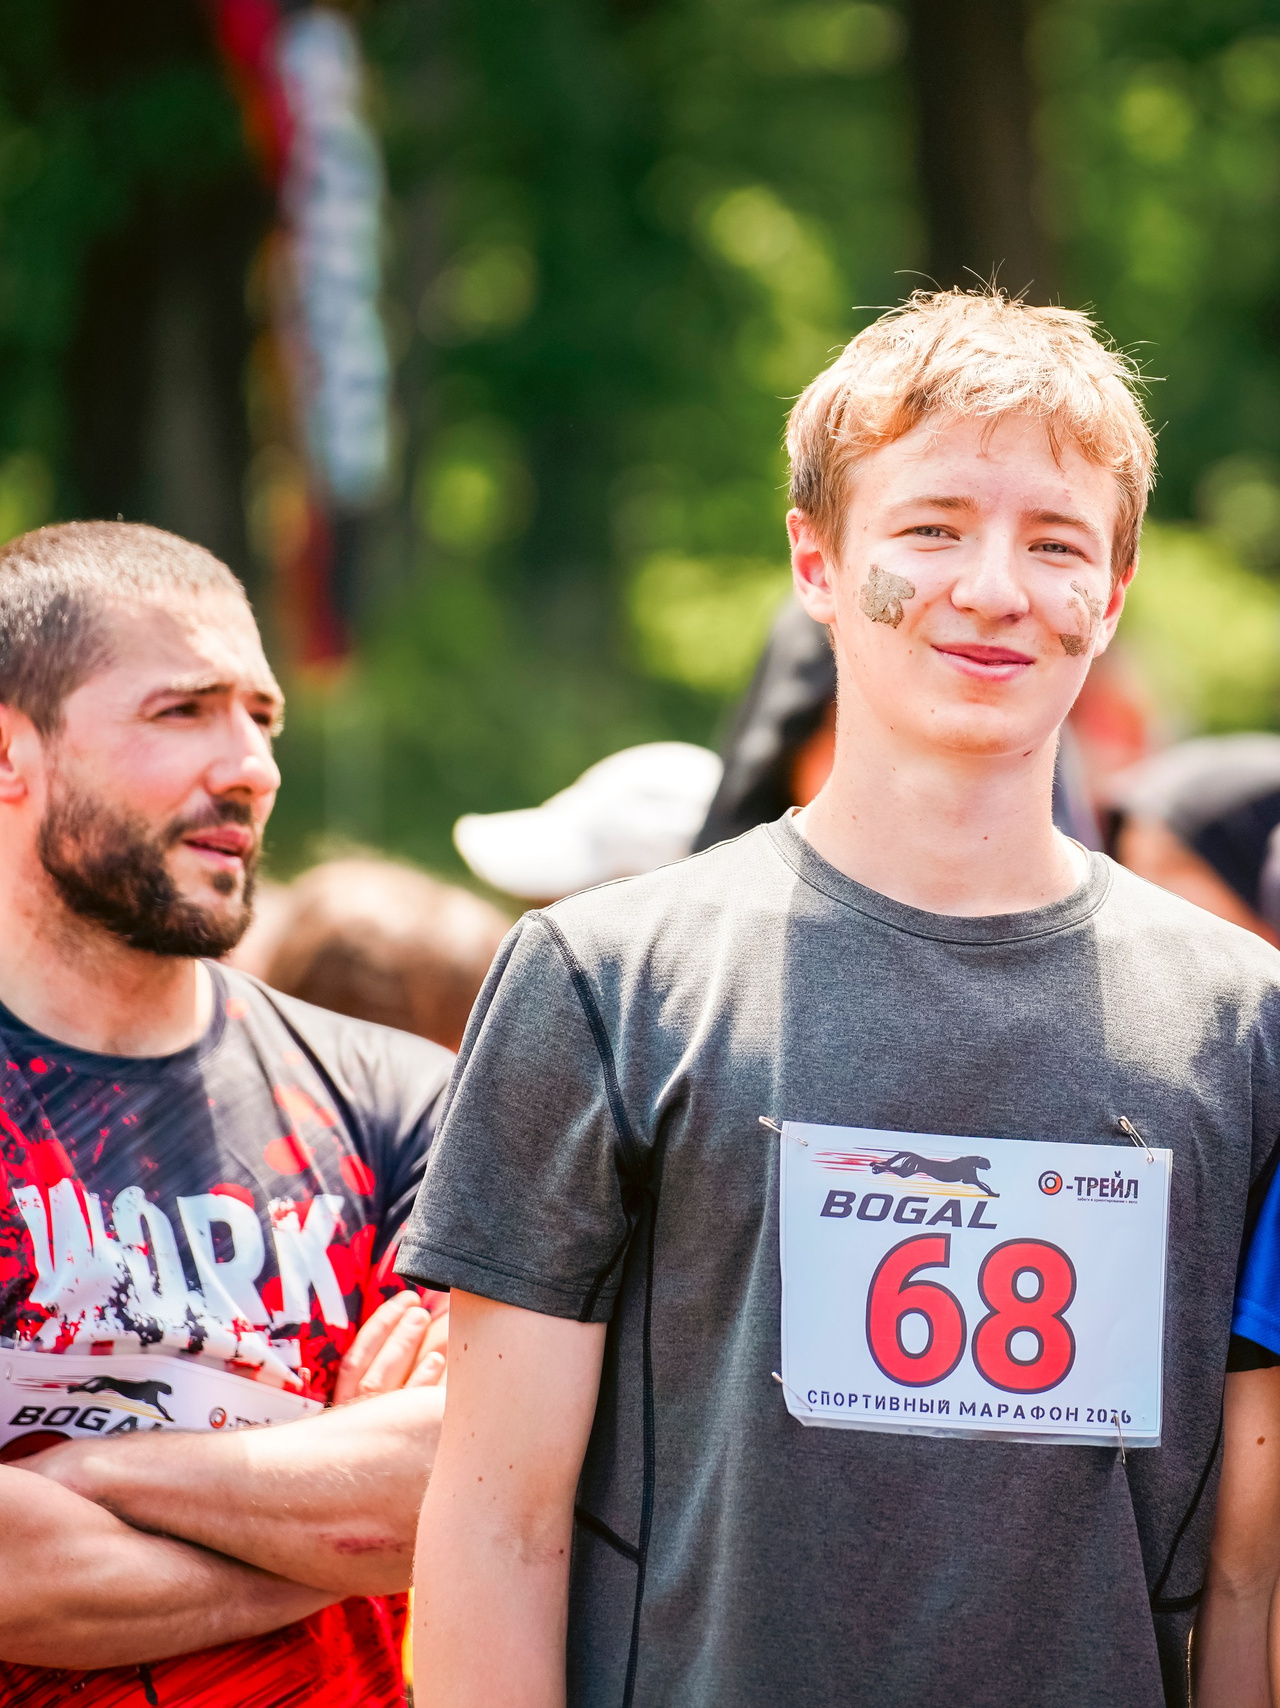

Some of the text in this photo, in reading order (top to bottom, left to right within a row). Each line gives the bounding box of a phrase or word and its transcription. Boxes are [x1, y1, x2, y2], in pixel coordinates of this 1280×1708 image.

[819, 1188, 999, 1231] BOGAL
[12, 1177, 349, 1330] WORK
[865, 1231, 1078, 1396] 68
[9, 1404, 164, 1435] BOGA
[806, 1388, 951, 1416] СПОРТИВНЫЙ
[958, 1400, 1080, 1423] МАРАФОН
